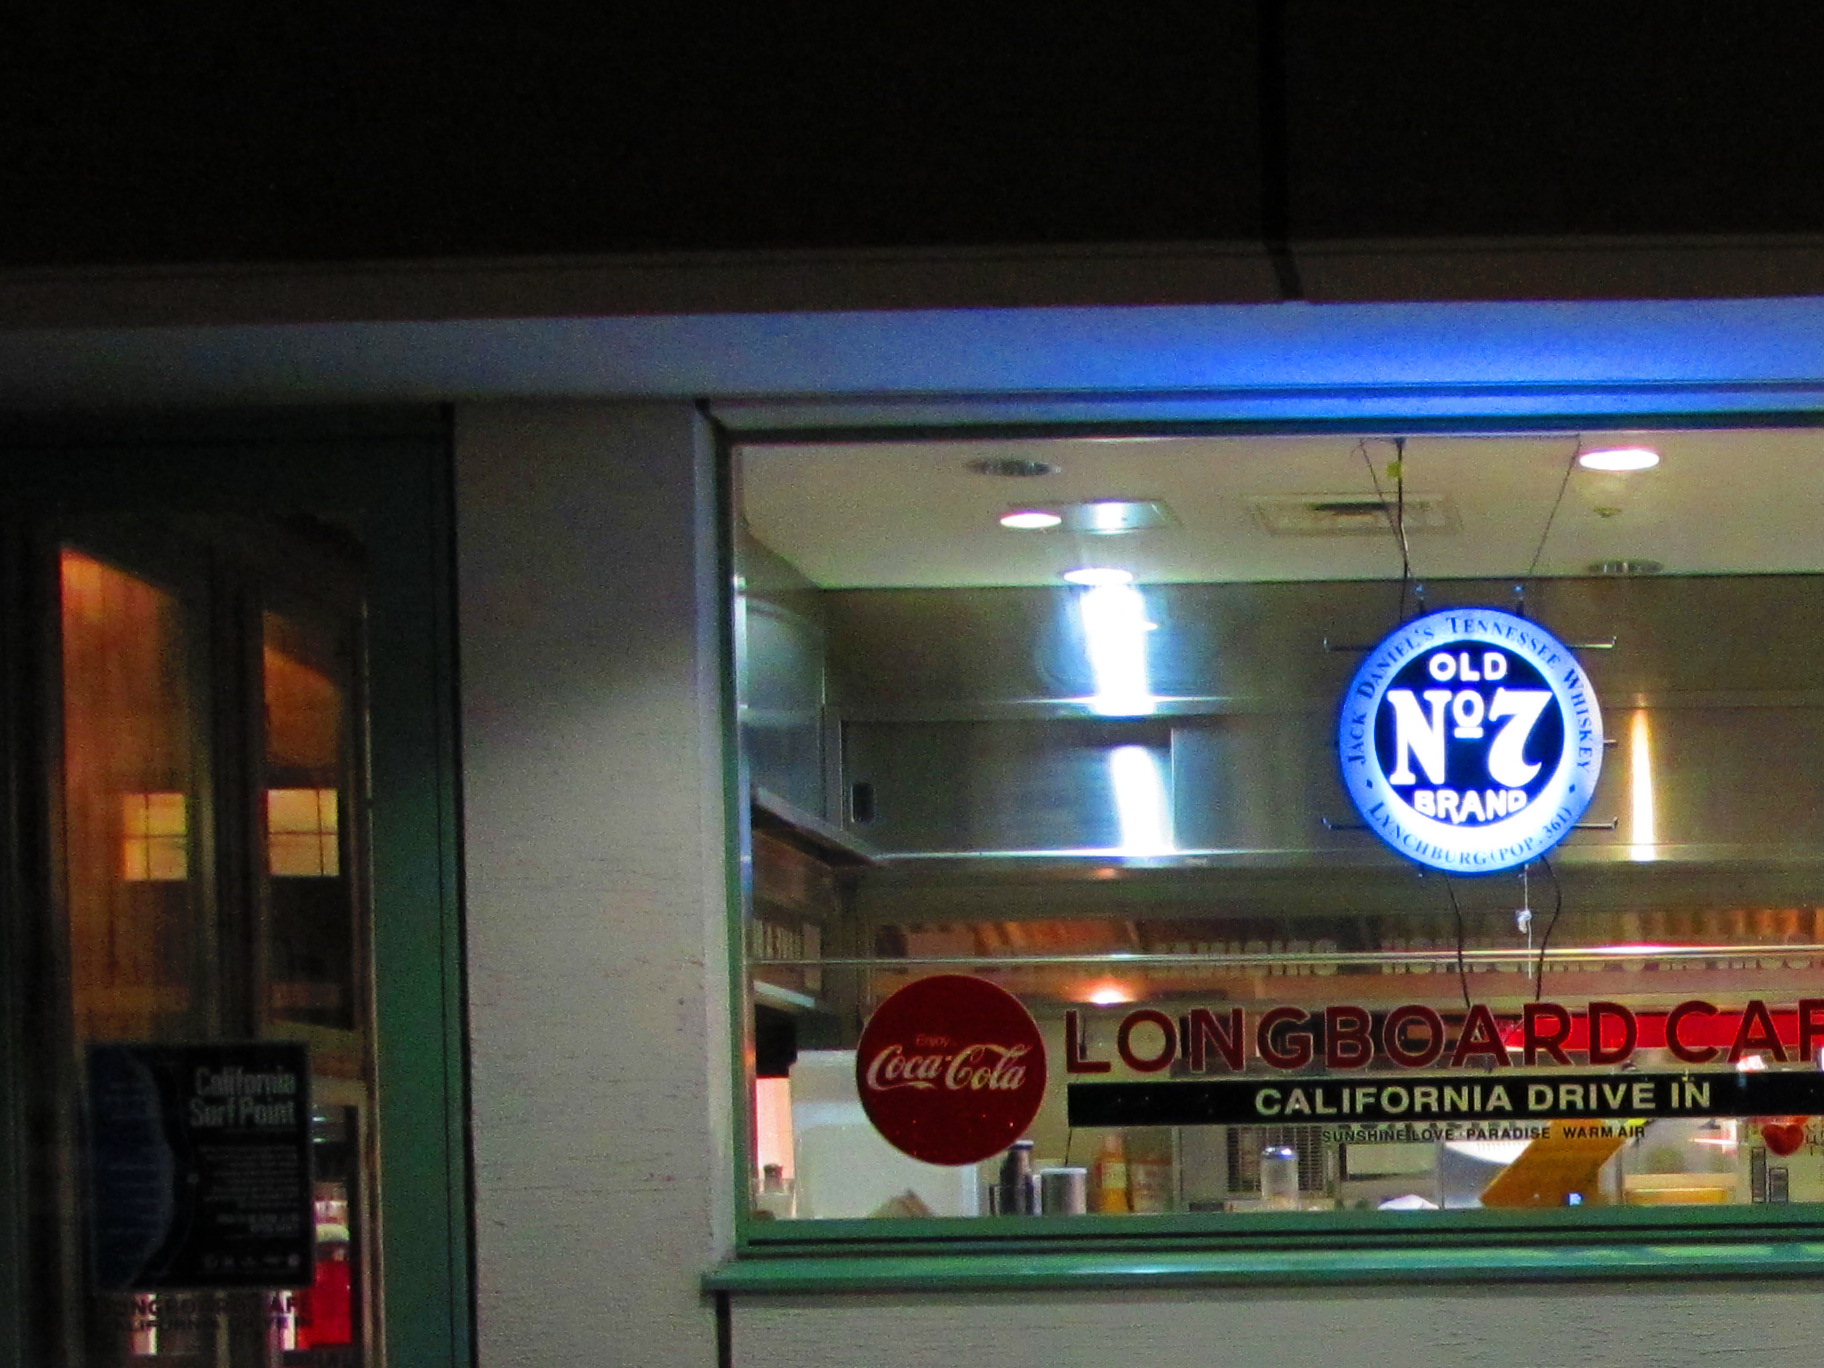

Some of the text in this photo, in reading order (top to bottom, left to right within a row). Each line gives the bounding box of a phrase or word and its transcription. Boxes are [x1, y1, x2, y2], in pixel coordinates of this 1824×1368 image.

[1429, 652, 1507, 681] OLD
[1348, 713, 1366, 766] JACK
[1446, 616, 1560, 668] TENNESSEE
[1563, 668, 1593, 772] WHISKEY
[1414, 789, 1528, 824] BRAND
[1065, 1002, 1638, 1073] LONGBOARD
[866, 1044, 1032, 1091] Coca-Cola
[1255, 1081, 1710, 1116] CALIFORNIA DRIVE IN
[1323, 1126, 1646, 1143] SUNSHINE LOVE PARADISE WARM AIR
